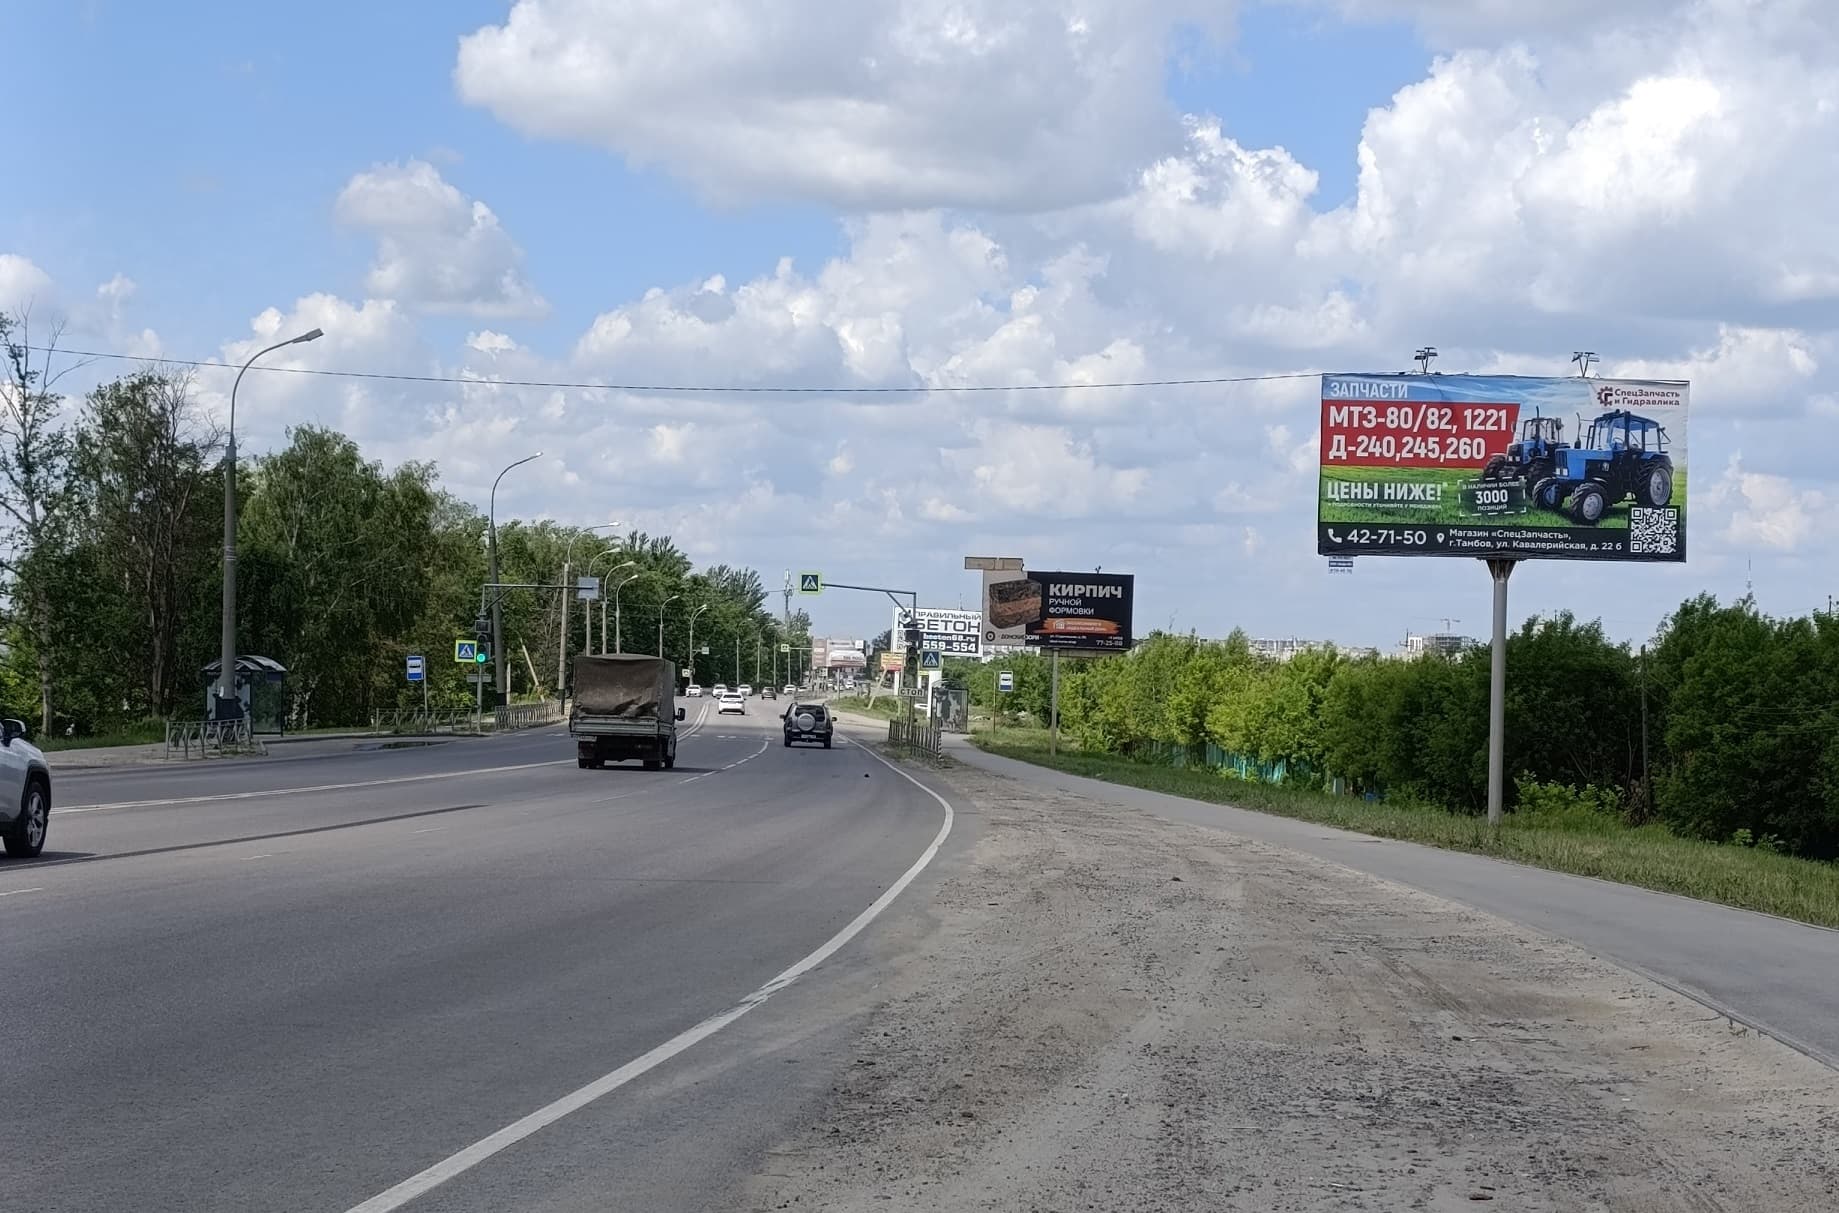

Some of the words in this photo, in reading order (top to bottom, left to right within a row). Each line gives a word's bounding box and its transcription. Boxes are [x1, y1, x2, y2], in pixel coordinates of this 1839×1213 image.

[1330, 382, 1408, 399] ЗАПЧАСТИ
[1614, 388, 1680, 398] СпецЗапчасть
[1622, 397, 1680, 407] Гидравлика
[1329, 404, 1458, 434] МТЗ-80/82,
[1464, 408, 1507, 431] 1221
[1328, 434, 1486, 463] Д-240,245,260
[1327, 481, 1378, 502] ЦЕНЫ
[1475, 489, 1509, 504] 3000
[1347, 529, 1427, 545] 42-71-50
[1449, 529, 1489, 538] Магазин
[1496, 541, 1509, 550] ул.
[1512, 540, 1588, 551] Кавалерийская,
[1590, 543, 1599, 551] д.
[1601, 542, 1613, 550] 22
[1049, 583, 1122, 598] КИРПИЧ
[1049, 598, 1082, 606] РУЧНОЙ
[1049, 607, 1095, 615] ФОРМОВКИ
[900, 688, 923, 696] СТОП
